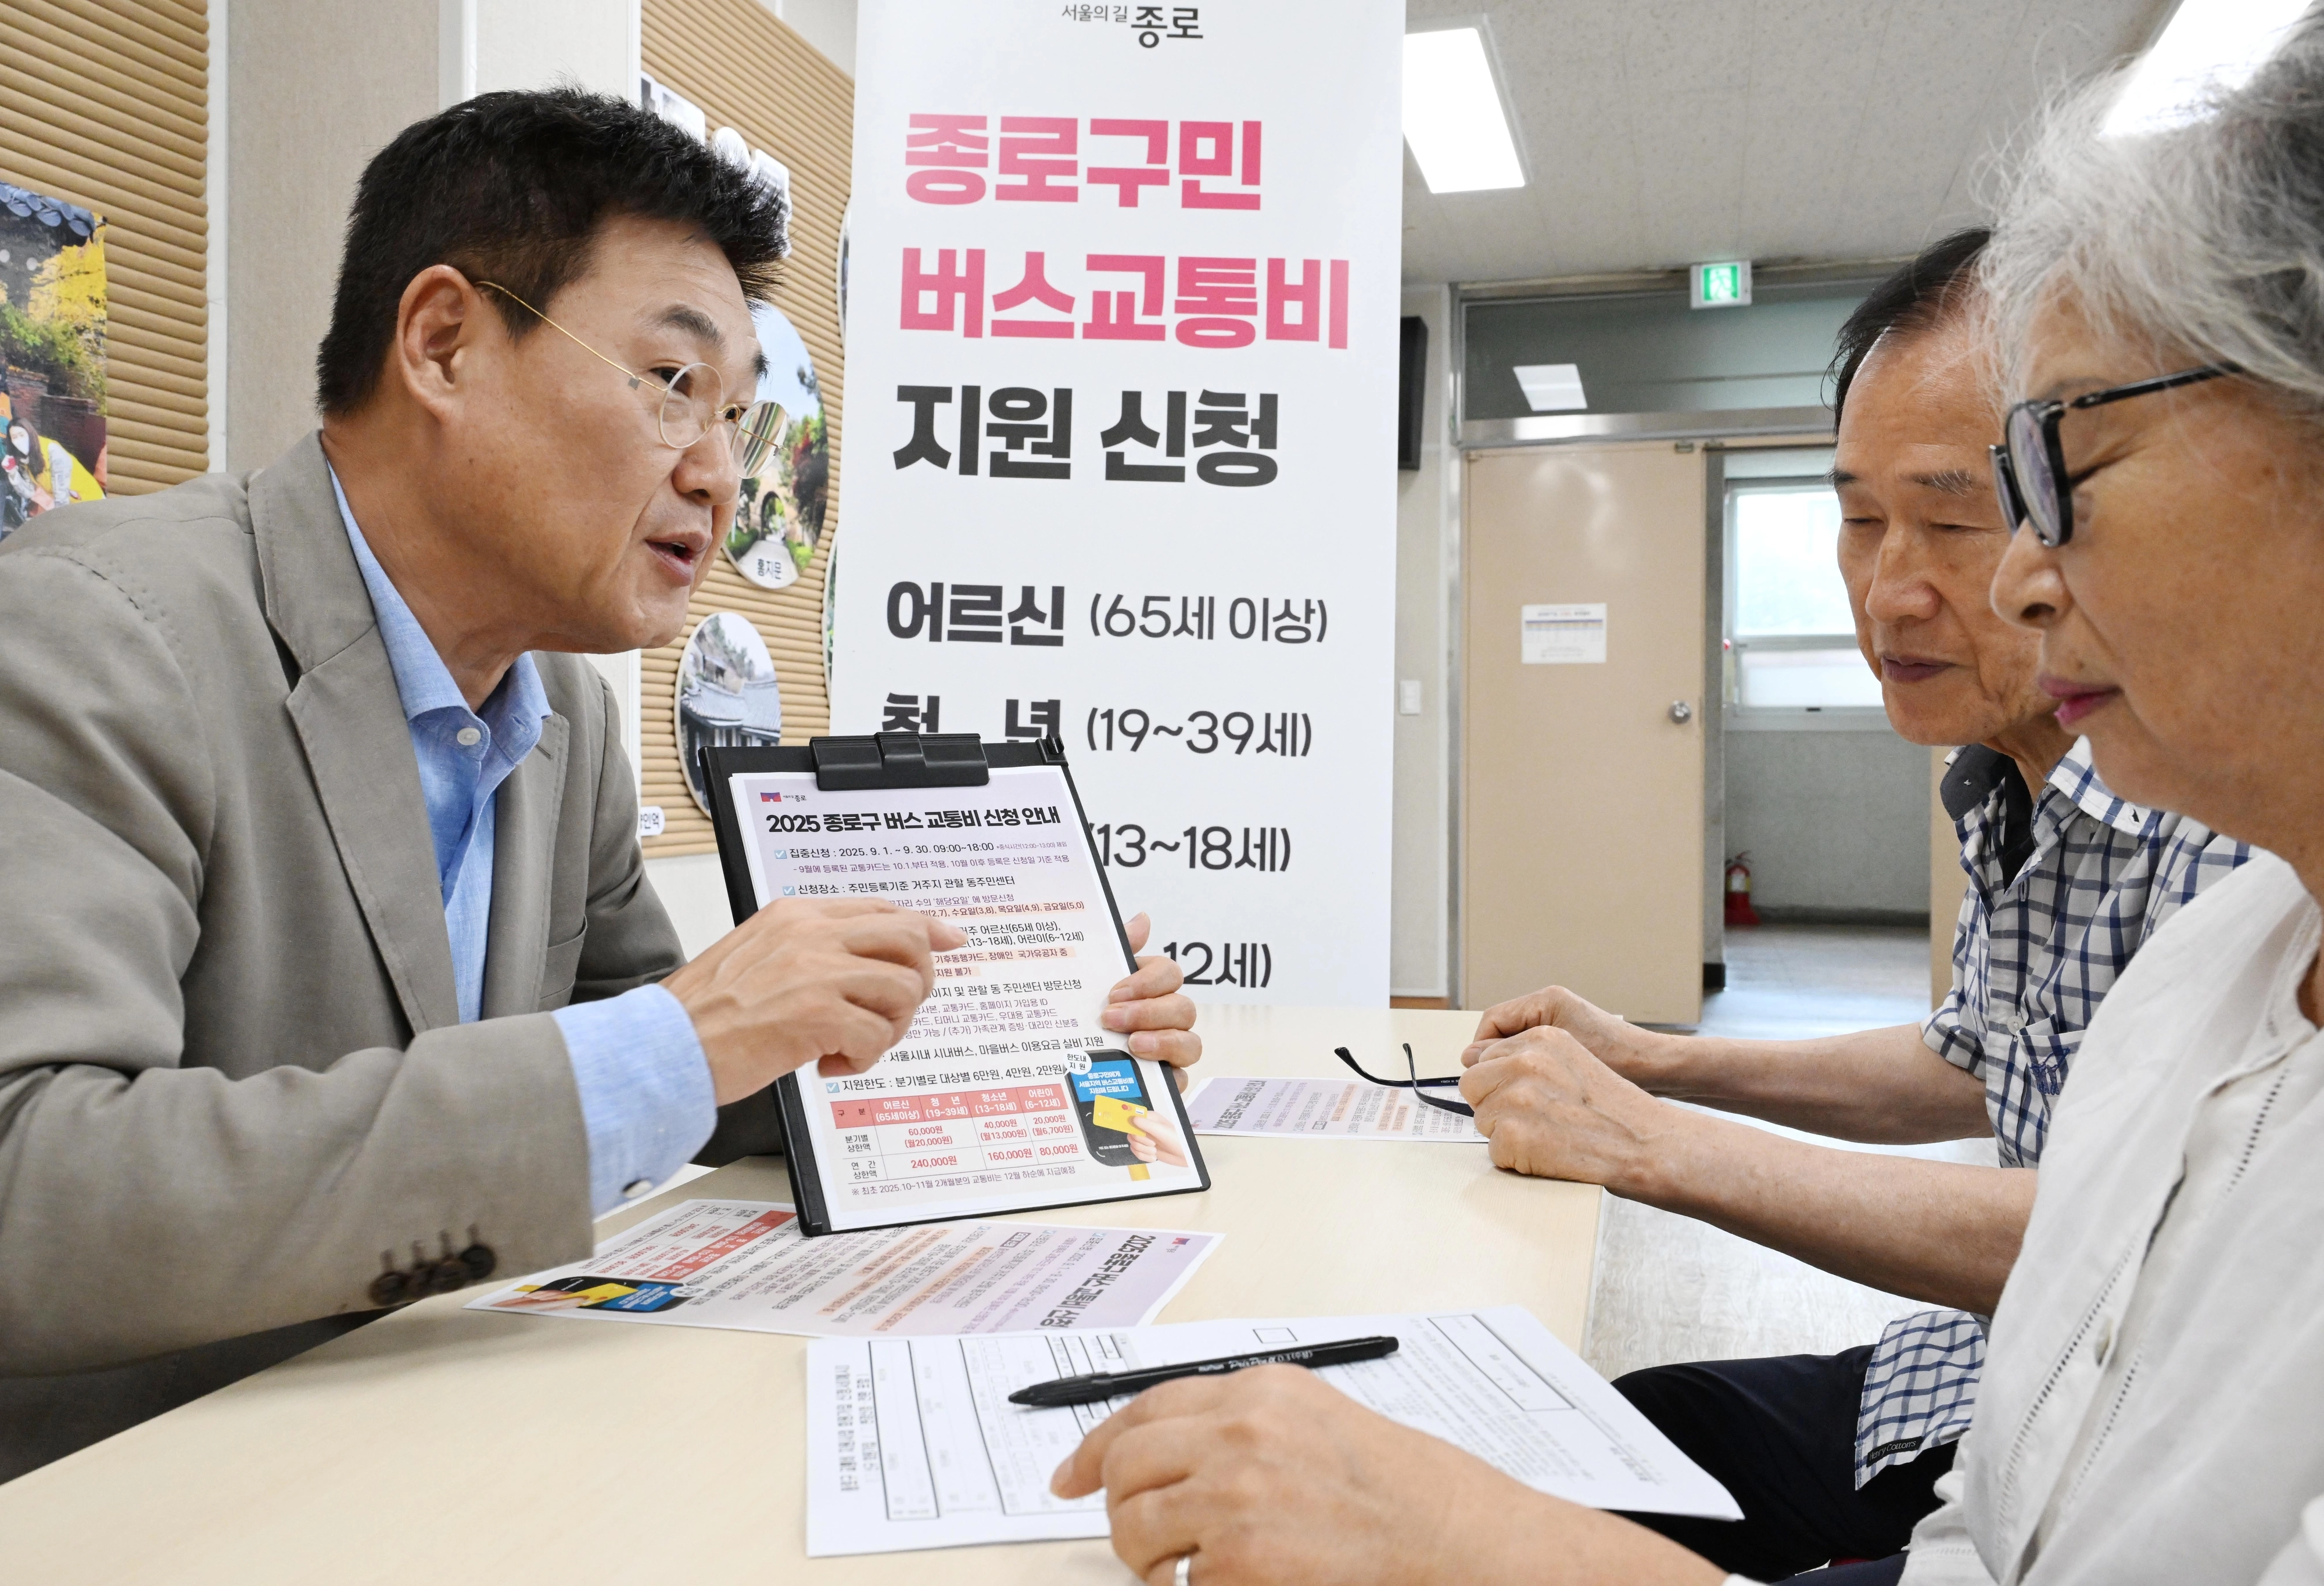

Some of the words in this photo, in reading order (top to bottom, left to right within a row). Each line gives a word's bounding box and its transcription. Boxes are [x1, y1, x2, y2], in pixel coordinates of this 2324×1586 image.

[1062, 5, 1107, 21] 서울의
[1113, 6, 1127, 22] 길
[1131, 6, 1203, 48] 종로
[905, 113, 1262, 211] 종로구민
[899, 247, 1349, 350] 버스교통비
[893, 385, 1073, 479] 지원
[1100, 388, 1278, 487] 신청
[887, 581, 1064, 647] 어르신
[1089, 593, 1215, 641] (65세
[1228, 596, 1328, 644] 이상)
[1086, 706, 1312, 758] (19~39세)
[766, 814, 821, 833] 2025
[823, 813, 881, 831] 종로구
[883, 812, 924, 829] 버스
[924, 810, 982, 828] 교통비
[984, 809, 1020, 826] 신청
[1021, 806, 1061, 825] 안내
[790, 848, 830, 858] 집중신청
[839, 848, 868, 857] 2025.
[870, 848, 880, 856] 9.
[883, 847, 892, 855] 1.
[903, 846, 913, 854] 9.
[916, 845, 931, 853] 30.
[934, 842, 994, 853] 09:00~18:00
[799, 864, 821, 873] 9월에
[823, 864, 848, 873] 등록된
[851, 863, 890, 871] 교통카드는
[893, 861, 928, 870] 10.1.부터
[930, 860, 949, 869] 적용,
[798, 884, 839, 894] 신청장소
[848, 881, 909, 893] 주민등록기준
[912, 880, 942, 891] 거주지
[945, 878, 964, 888] 관할
[967, 875, 1015, 887] 동주민센터
[915, 898, 931, 906] 수의
[982, 894, 1014, 903] 방문신청
[952, 906, 996, 916] 수요일(3,8),
[998, 904, 1042, 913] 목요일(4,9),
[1043, 901, 1084, 910] 금요일(5,0)
[980, 923, 1034, 934] 어르신(65세
[1036, 921, 1060, 932] 이상),
[1018, 931, 1084, 943] 어린이(6~12세)
[935, 953, 987, 963] 기후동행카드,
[989, 951, 1013, 960] 장애인
[1018, 949, 1057, 957] 국가유공자
[1060, 948, 1067, 956] 중
[955, 967, 971, 976] 불가
[955, 987, 964, 996] 및
[968, 985, 987, 995] 관할
[991, 984, 1001, 994] 동
[1003, 981, 1041, 993] 주민센터
[1043, 979, 1082, 991] 방문신청
[942, 1002, 978, 1013] 교통카드,
[980, 1000, 1012, 1010] 홈페이지
[1014, 999, 1038, 1008] 가입용
[935, 1017, 960, 1025] 티머니
[963, 1013, 998, 1022] 교통카드,
[999, 1011, 1023, 1020] 우대용
[1027, 1009, 1057, 1018] 교통카드
[924, 1029, 941, 1037] 가능
[948, 1025, 971, 1035] (추가)
[974, 1023, 1006, 1034] 가족관계
[1055, 1018, 1078, 1028] 신분증
[890, 1049, 931, 1062] 서울시내
[934, 1046, 977, 1058] 시내버스,
[980, 1042, 1018, 1054] 마을버스
[1021, 1041, 1060, 1052] 이용요금
[1063, 1038, 1082, 1049] 실비
[1084, 1036, 1104, 1047] 지원
[1067, 1054, 1086, 1062] 한도내
[842, 1078, 886, 1090] 지원한도
[895, 1075, 938, 1087] 분기별로
[939, 1073, 971, 1083] 대상별
[973, 1070, 1003, 1081] 6만원,
[1006, 1067, 1035, 1078] 4만원,
[1037, 1064, 1063, 1075] 2만원
[1079, 1080, 1101, 1088] 서울지역
[981, 1092, 1007, 1101] 청소년
[1028, 1088, 1053, 1098] 어린이
[884, 1100, 909, 1110] 어르신
[975, 1102, 1017, 1114] (13~18세)
[1025, 1098, 1061, 1109] (6~12세)
[876, 1110, 919, 1121] (65세이상)
[926, 1106, 968, 1118] (19~39세)
[984, 1119, 1017, 1129] 40,000원
[1033, 1115, 1066, 1124] 20,000원
[909, 1126, 943, 1136] 60,000원
[980, 1129, 1027, 1141] (월13,000원)
[1032, 1125, 1074, 1136] (월6,700원)
[845, 1135, 868, 1143] 분기별
[905, 1136, 952, 1148] (월20,000원)
[847, 1144, 870, 1152] 상한액
[1040, 1144, 1078, 1156] 80,000원
[988, 1149, 1032, 1161] 160,000원
[911, 1156, 957, 1169] 240,000원
[853, 1170, 877, 1179] 상한액
[862, 1187, 878, 1195] 최초
[880, 1180, 933, 1193] 2025.10~11월
[935, 1176, 970, 1187] 2개월분의
[973, 1174, 1002, 1183] 교통비는
[1005, 1172, 1020, 1180] 12월
[1023, 1169, 1044, 1178] 하순에
[1047, 1166, 1075, 1175] 지급예정
[1869, 1447, 1887, 1461] Henry
